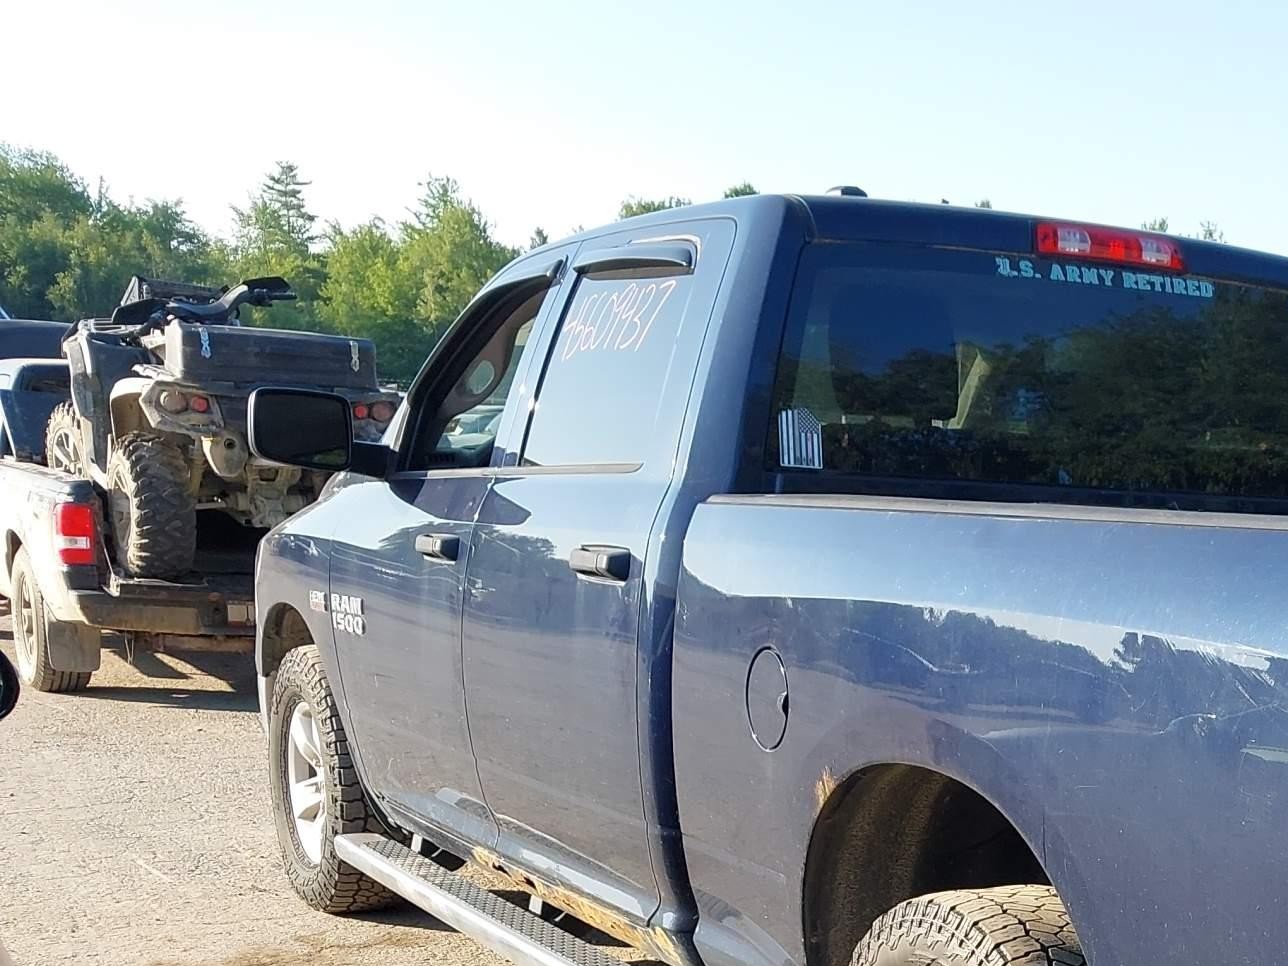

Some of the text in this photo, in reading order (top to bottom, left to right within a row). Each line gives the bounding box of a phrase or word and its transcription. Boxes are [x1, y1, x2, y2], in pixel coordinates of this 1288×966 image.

[995, 257, 1214, 298] U.S. ARMY RETIRED
[330, 593, 364, 615] RAM
[331, 611, 366, 635] 1500
